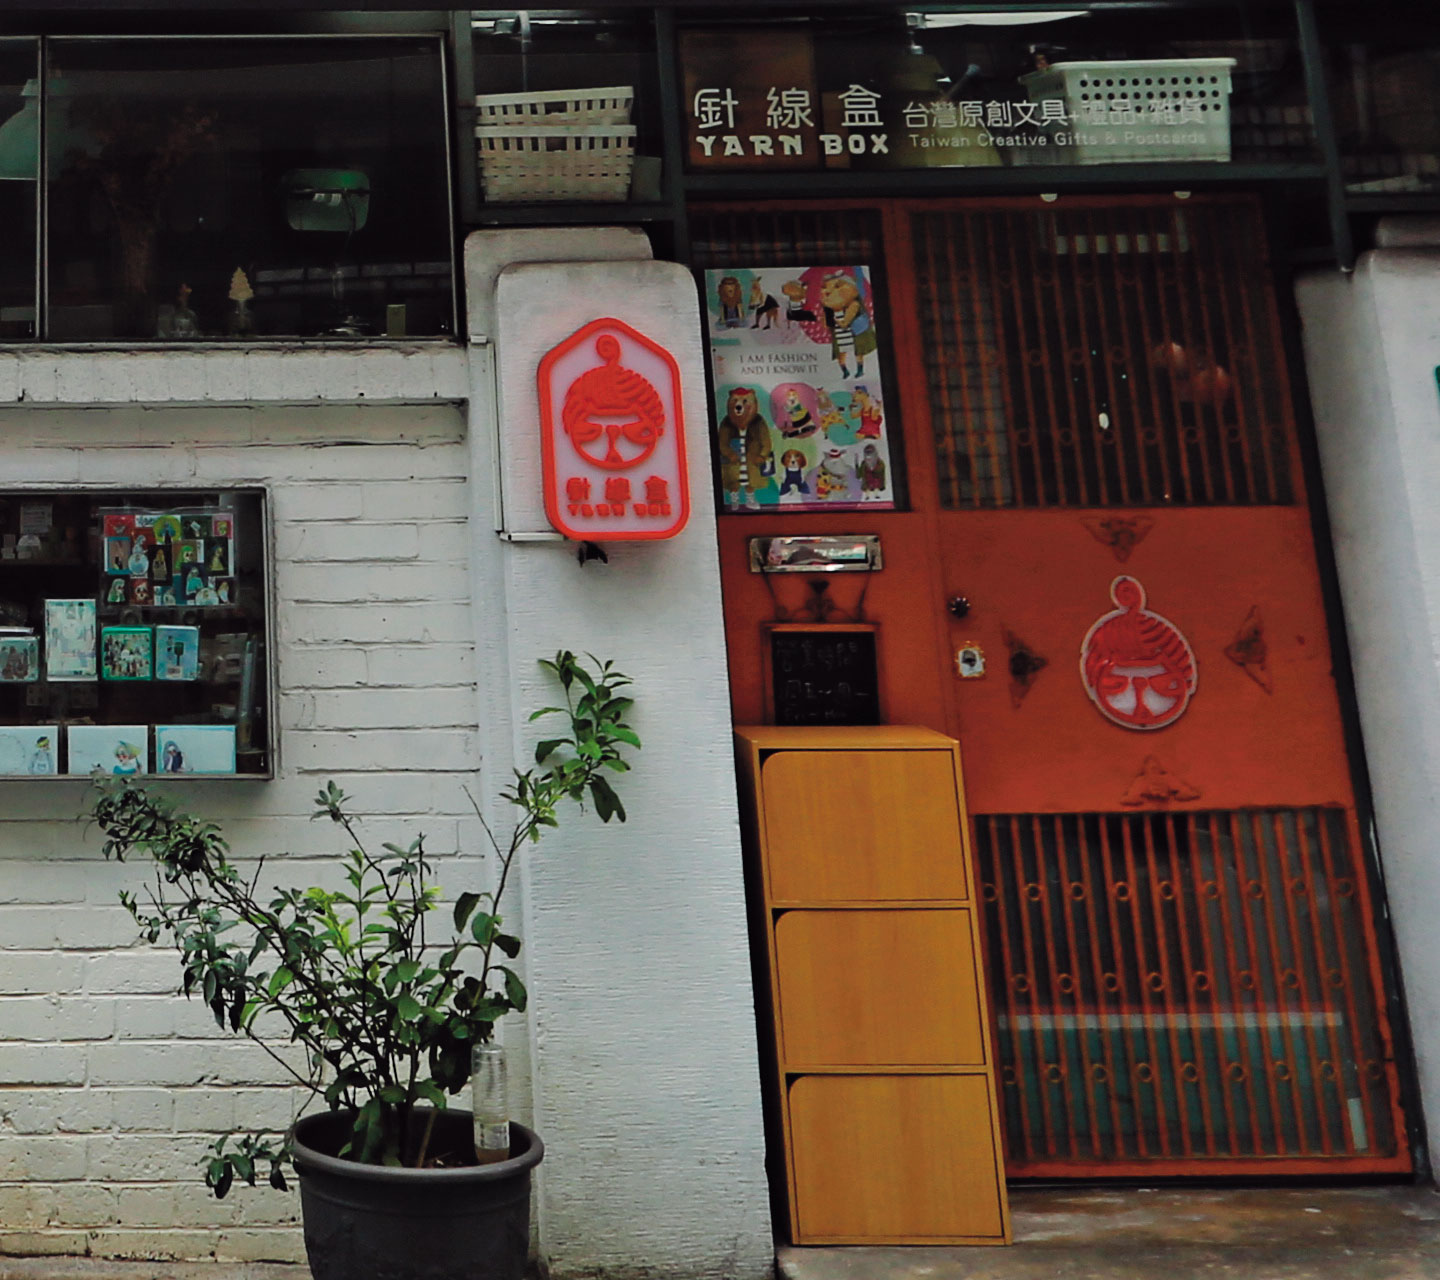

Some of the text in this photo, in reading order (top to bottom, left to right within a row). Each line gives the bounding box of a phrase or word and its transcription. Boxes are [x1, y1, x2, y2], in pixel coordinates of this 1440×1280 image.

[694, 85, 884, 129] 針線盒
[696, 134, 889, 156] YARN BOX
[908, 134, 970, 148] Taiwan
[977, 132, 1047, 147] Creative
[1054, 131, 1098, 146] Gifts
[1124, 131, 1207, 145] Postcards
[748, 354, 764, 363] AM
[768, 352, 818, 363] FASHION
[741, 366, 763, 375] AND
[773, 365, 804, 374] KNOW
